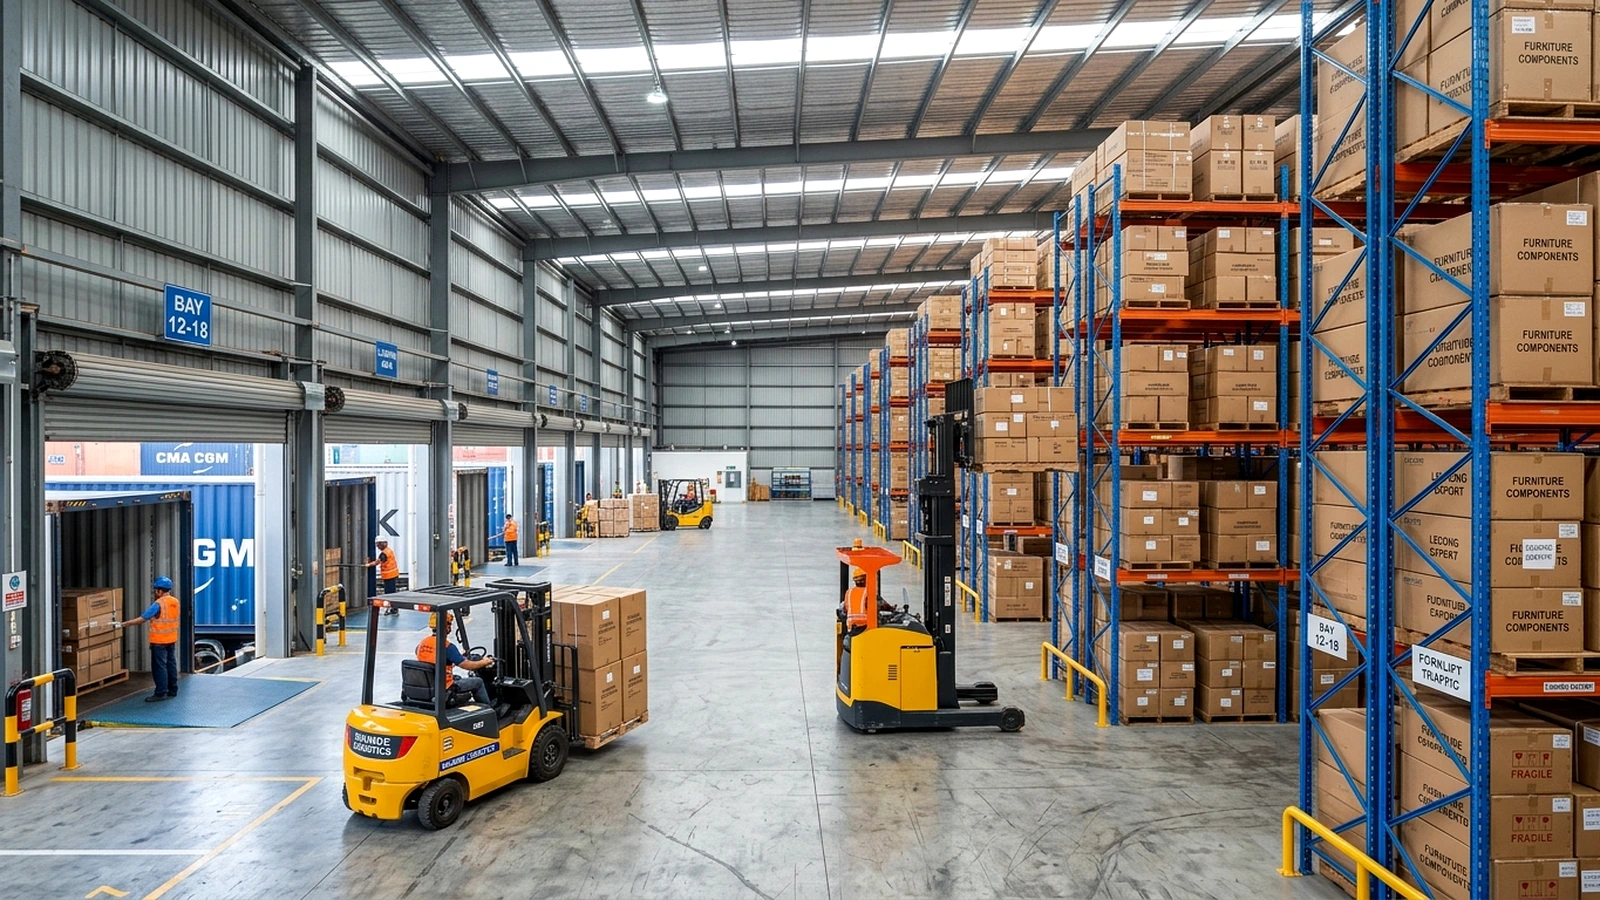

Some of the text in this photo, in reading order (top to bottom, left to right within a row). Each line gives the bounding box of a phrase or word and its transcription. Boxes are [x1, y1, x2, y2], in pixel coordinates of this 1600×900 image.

[1523, 238, 1573, 248] FURNITURE
[174, 294, 204, 316] BAY
[168, 315, 208, 339] 12-18
[1522, 330, 1572, 340] FURNITURE
[1516, 343, 1579, 353] COMPONENTS
[156, 452, 229, 464] CMA CGM
[1512, 476, 1565, 486] FURNITURE
[1505, 488, 1570, 498] COMPONENTS
[1512, 610, 1565, 620] FURNITURE
[1319, 622, 1335, 635] BAY
[1505, 622, 1570, 632] COMPONENTS
[1511, 769, 1553, 779] FRAGILE
